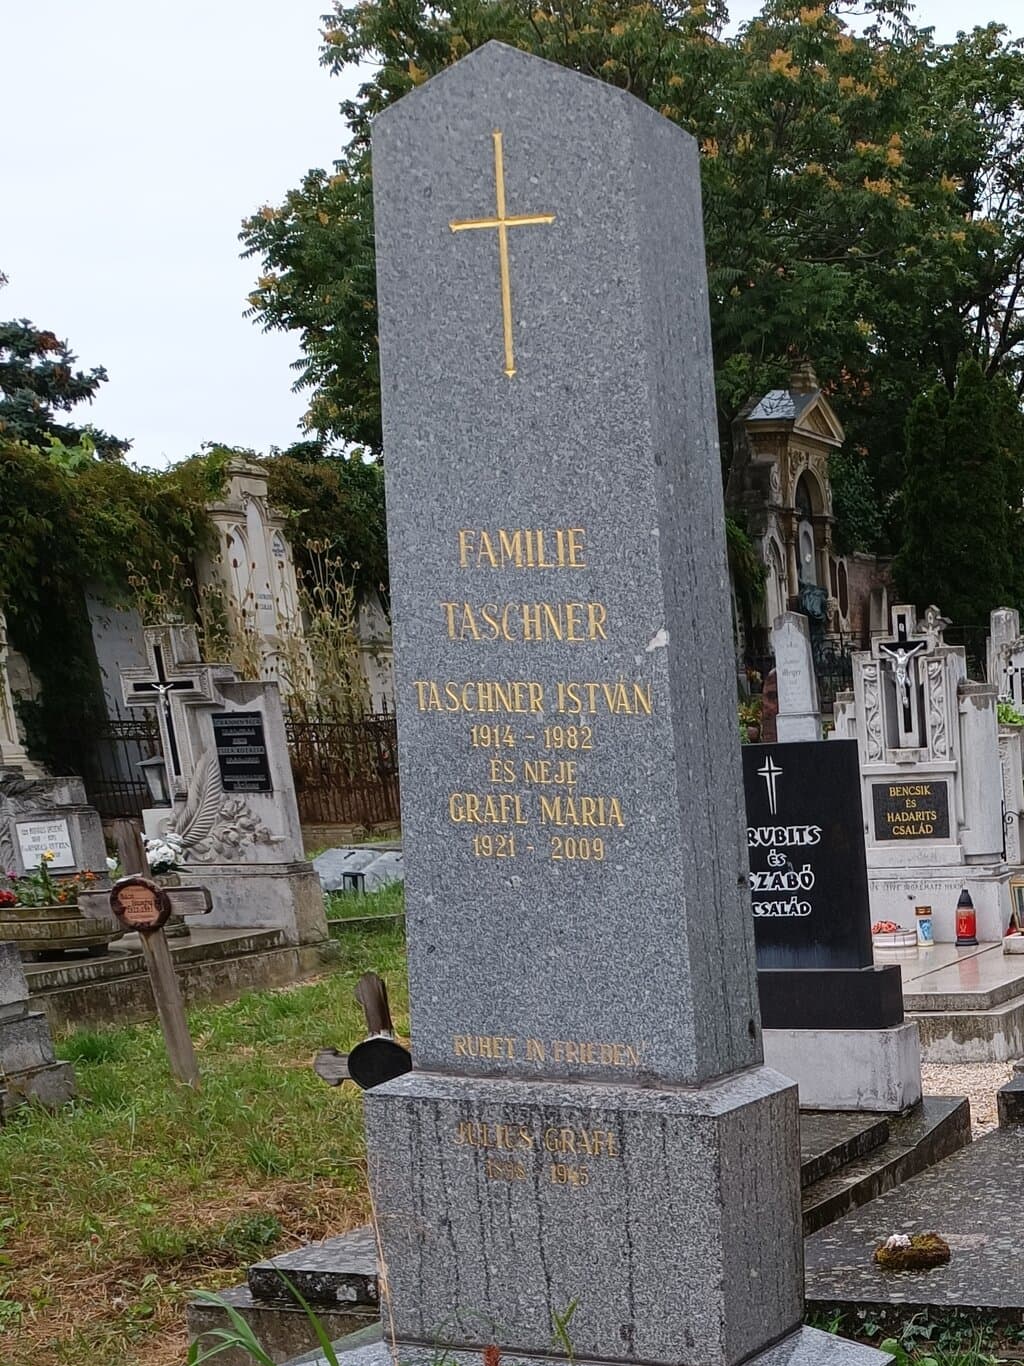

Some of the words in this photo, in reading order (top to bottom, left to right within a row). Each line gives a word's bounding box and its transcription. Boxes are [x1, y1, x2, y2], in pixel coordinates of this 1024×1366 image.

[457, 528, 587, 569] FAMILIE
[440, 601, 608, 641] TASCHNER
[413, 680, 545, 713] TASCHNER
[556, 675, 654, 715] ISTVÁN
[470, 724, 515, 748] 1914
[544, 725, 593, 750] 1982
[490, 753, 517, 783] ÉS
[523, 761, 577, 784] NEJE
[889, 785, 931, 797] BENCSIK
[906, 798, 917, 808] ÉS
[450, 793, 528, 824] GRAFL
[540, 788, 625, 827] MÁRIA
[887, 811, 937, 822] HADARITS
[892, 824, 933, 835] CSALÁD
[472, 834, 516, 857] 1921
[550, 836, 605, 861] 2009
[748, 864, 815, 891] SZABÓ
[752, 896, 812, 917] CSALÁD
[453, 1034, 516, 1060] RUHET
[526, 1037, 545, 1062] IN
[453, 1121, 534, 1150] JULIUS
[544, 1127, 620, 1158] GRAFL
